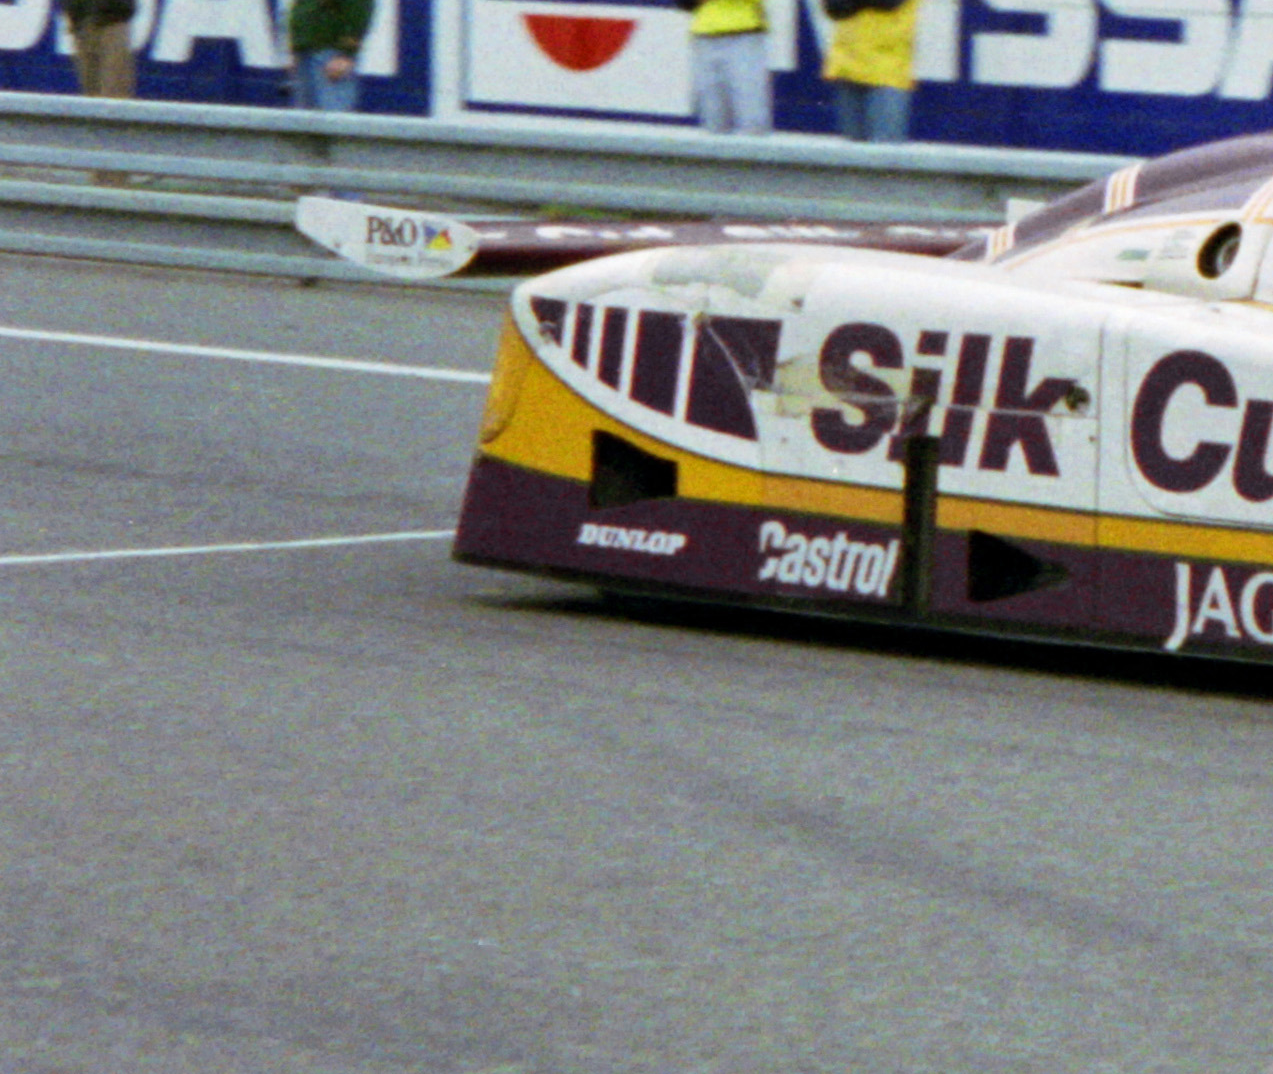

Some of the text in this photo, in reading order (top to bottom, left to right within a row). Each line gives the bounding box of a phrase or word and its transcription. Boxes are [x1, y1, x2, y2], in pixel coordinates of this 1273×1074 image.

[365, 216, 417, 247] P&O
[810, 322, 1080, 478] Silk
[577, 523, 687, 556] DUNLOP
[759, 521, 899, 597] Castrol
